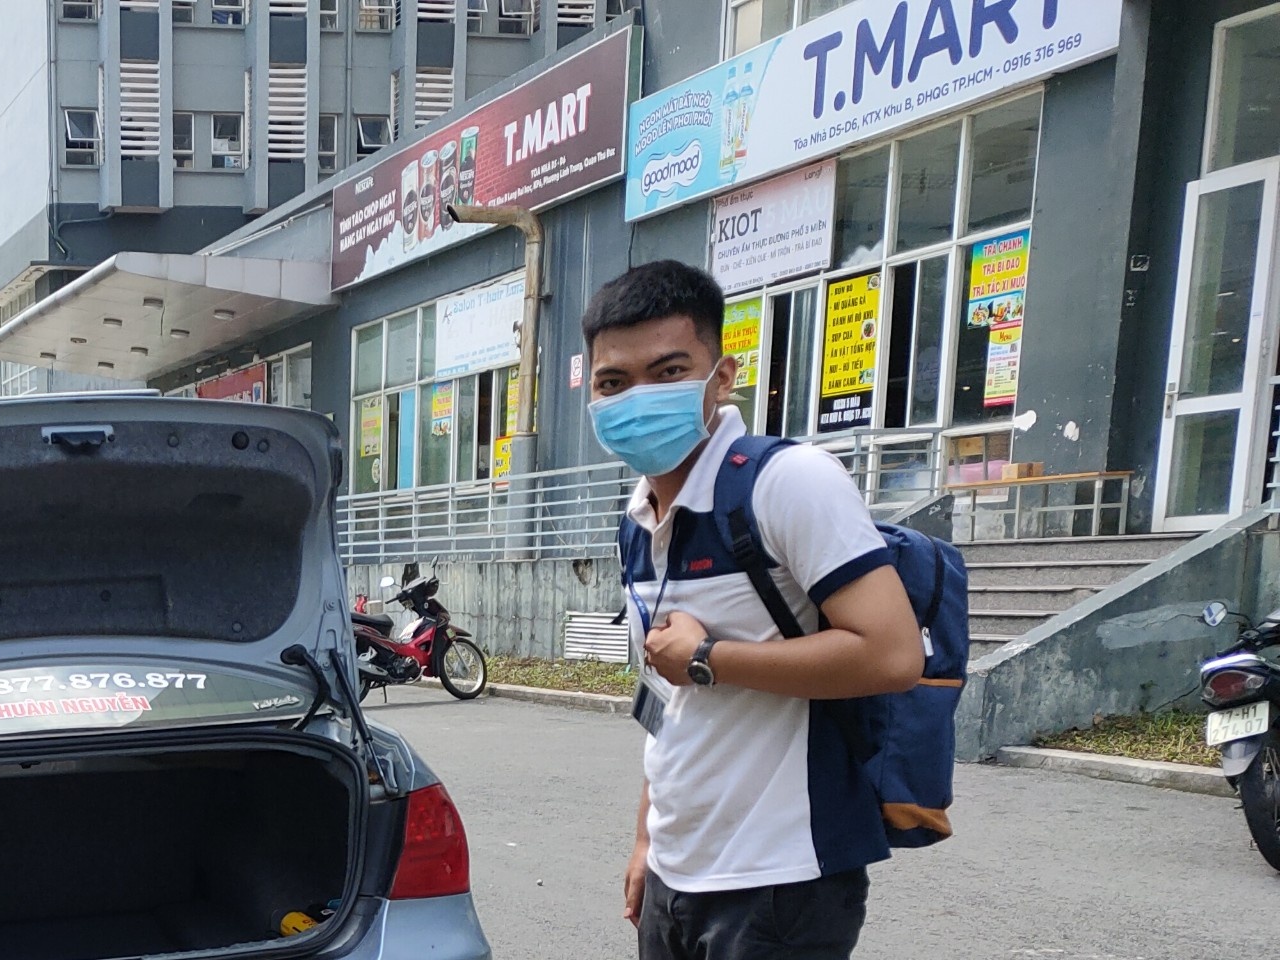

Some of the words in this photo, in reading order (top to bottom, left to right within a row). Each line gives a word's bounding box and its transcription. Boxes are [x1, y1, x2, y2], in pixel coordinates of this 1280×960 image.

[639, 108, 661, 135] NGON
[662, 97, 679, 118] MÁT
[678, 90, 692, 110] BẤT
[692, 90, 712, 108] NGỜ
[793, 137, 808, 151] Tòa
[810, 130, 827, 146] Nhà
[829, 118, 860, 139] D5-D6,
[862, 111, 882, 127] KTX
[884, 102, 902, 119] Khu
[905, 97, 914, 112] B,
[917, 83, 950, 106] ĐHQG
[952, 66, 993, 91] TP.HCM
[1003, 51, 1031, 74] 0916
[1034, 43, 1054, 62] 316
[1058, 33, 1082, 53] 969
[504, 83, 592, 167] T.MART
[635, 128, 657, 157] MOOD
[658, 118, 672, 137] LÊN
[673, 112, 693, 130] PHƠI
[643, 150, 700, 192] goodmood
[718, 207, 762, 243] KIOT
[999, 237, 1023, 253] CHANH
[62, 692, 152, 714] NGUYỄN
[1212, 718, 1263, 742] 274.07
